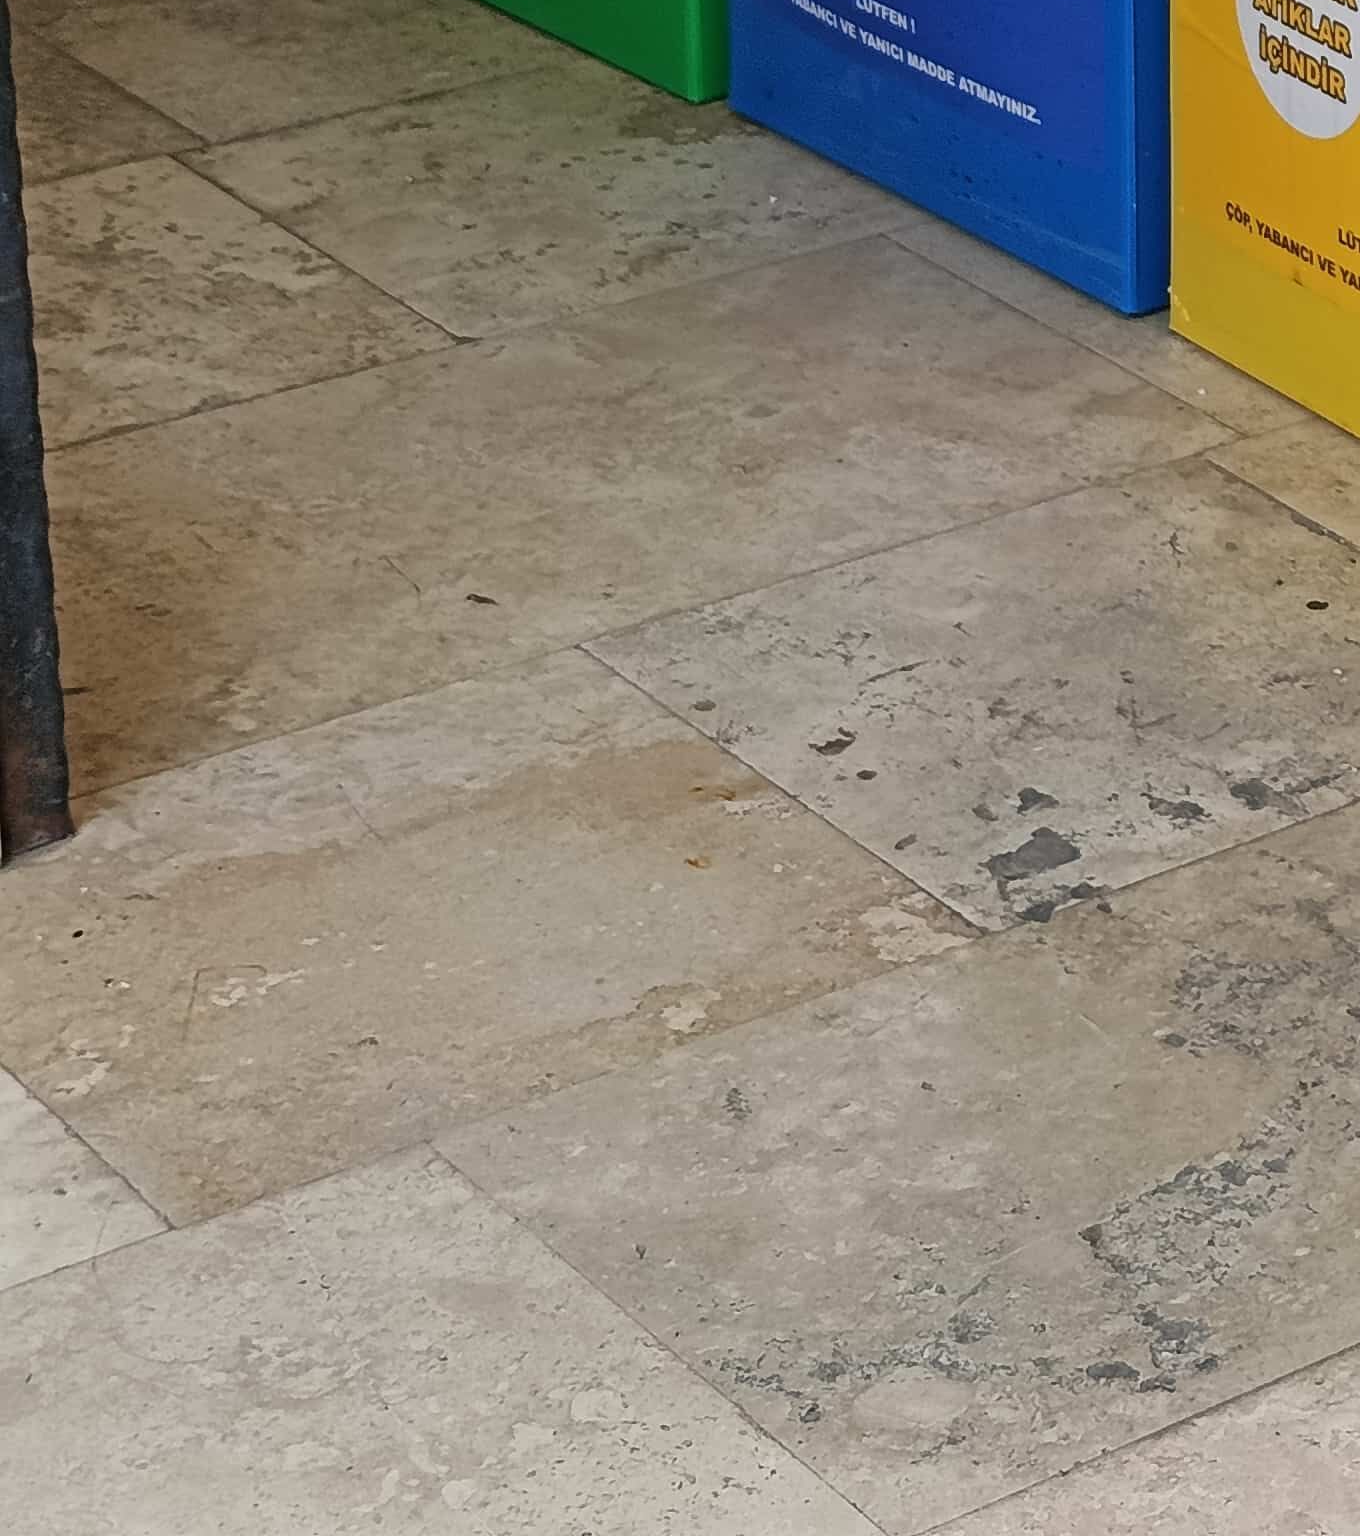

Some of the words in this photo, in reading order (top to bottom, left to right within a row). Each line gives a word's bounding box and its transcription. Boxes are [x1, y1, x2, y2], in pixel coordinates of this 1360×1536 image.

[840, 17, 856, 39] VE
[859, 28, 903, 63] YANICI
[908, 50, 955, 87] MADDE
[959, 74, 1042, 125] ATMAYINIZ.
[1259, 25, 1346, 104] İÇİNDİR
[1225, 201, 1253, 233] ÇÖP,
[1256, 219, 1314, 264] YABANCI
[1318, 254, 1336, 277] VE
